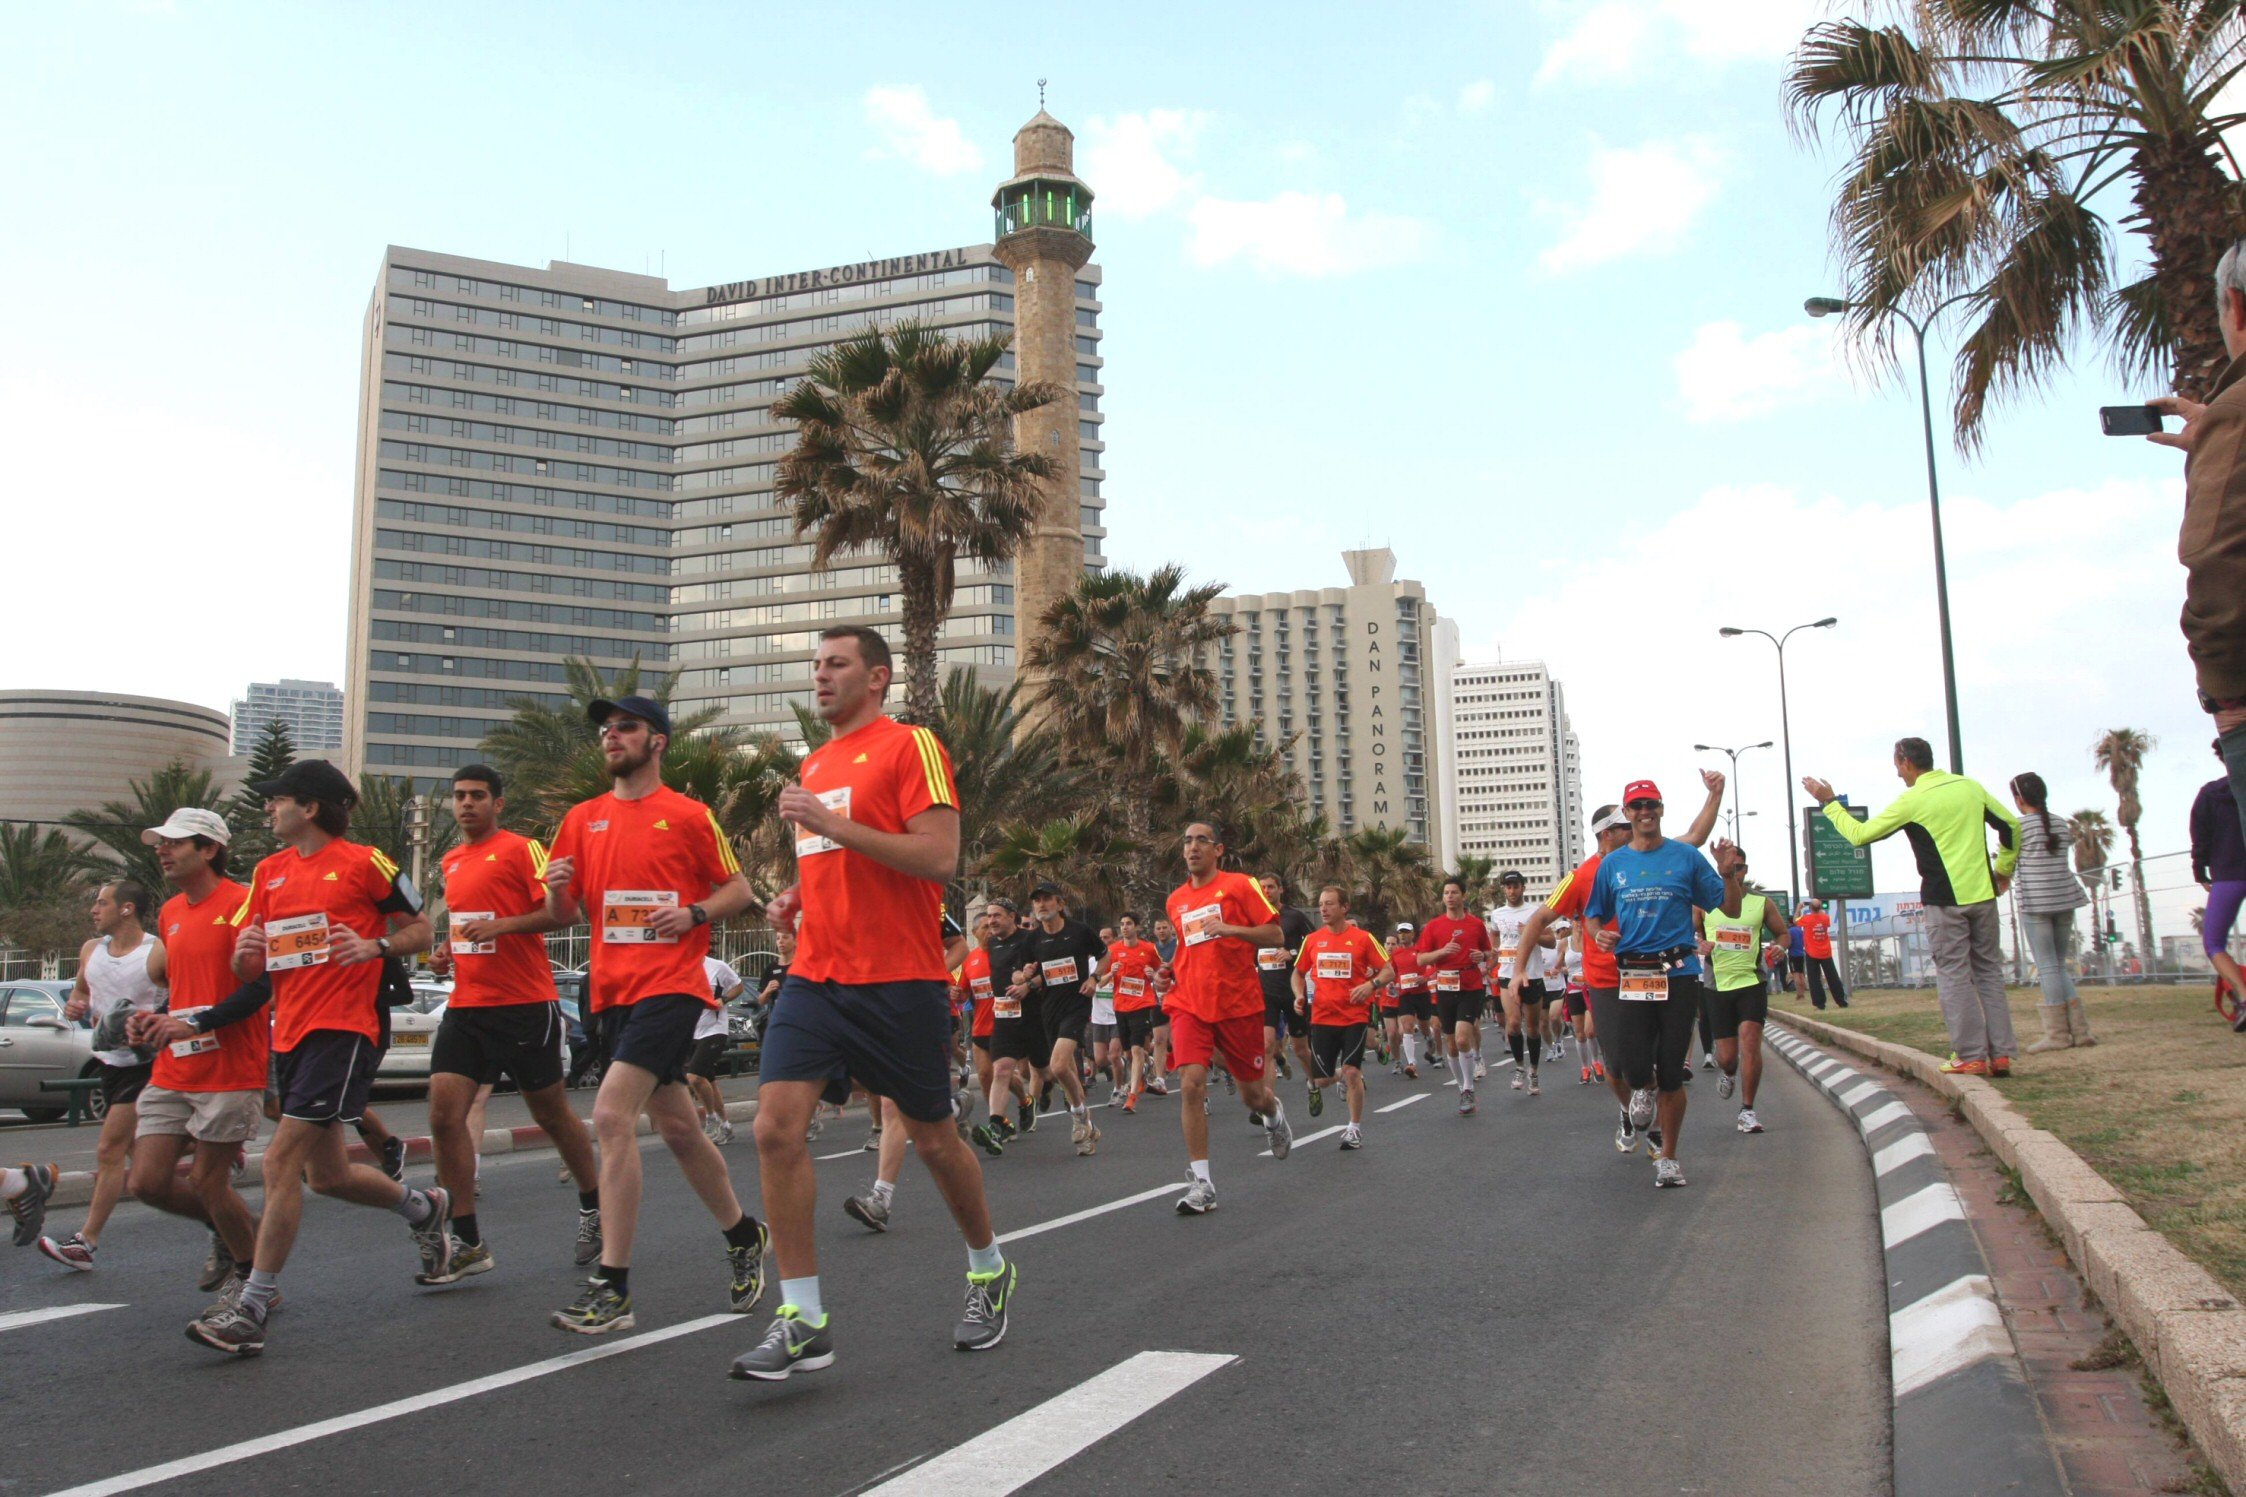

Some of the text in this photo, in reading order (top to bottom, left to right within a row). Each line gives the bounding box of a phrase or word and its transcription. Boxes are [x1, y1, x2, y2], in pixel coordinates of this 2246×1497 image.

[706, 280, 757, 304] DAVID
[1367, 622, 1388, 832] DAN PANORAMA
[608, 908, 619, 922] A
[269, 939, 280, 952] C
[1623, 980, 1667, 989] A 6430
